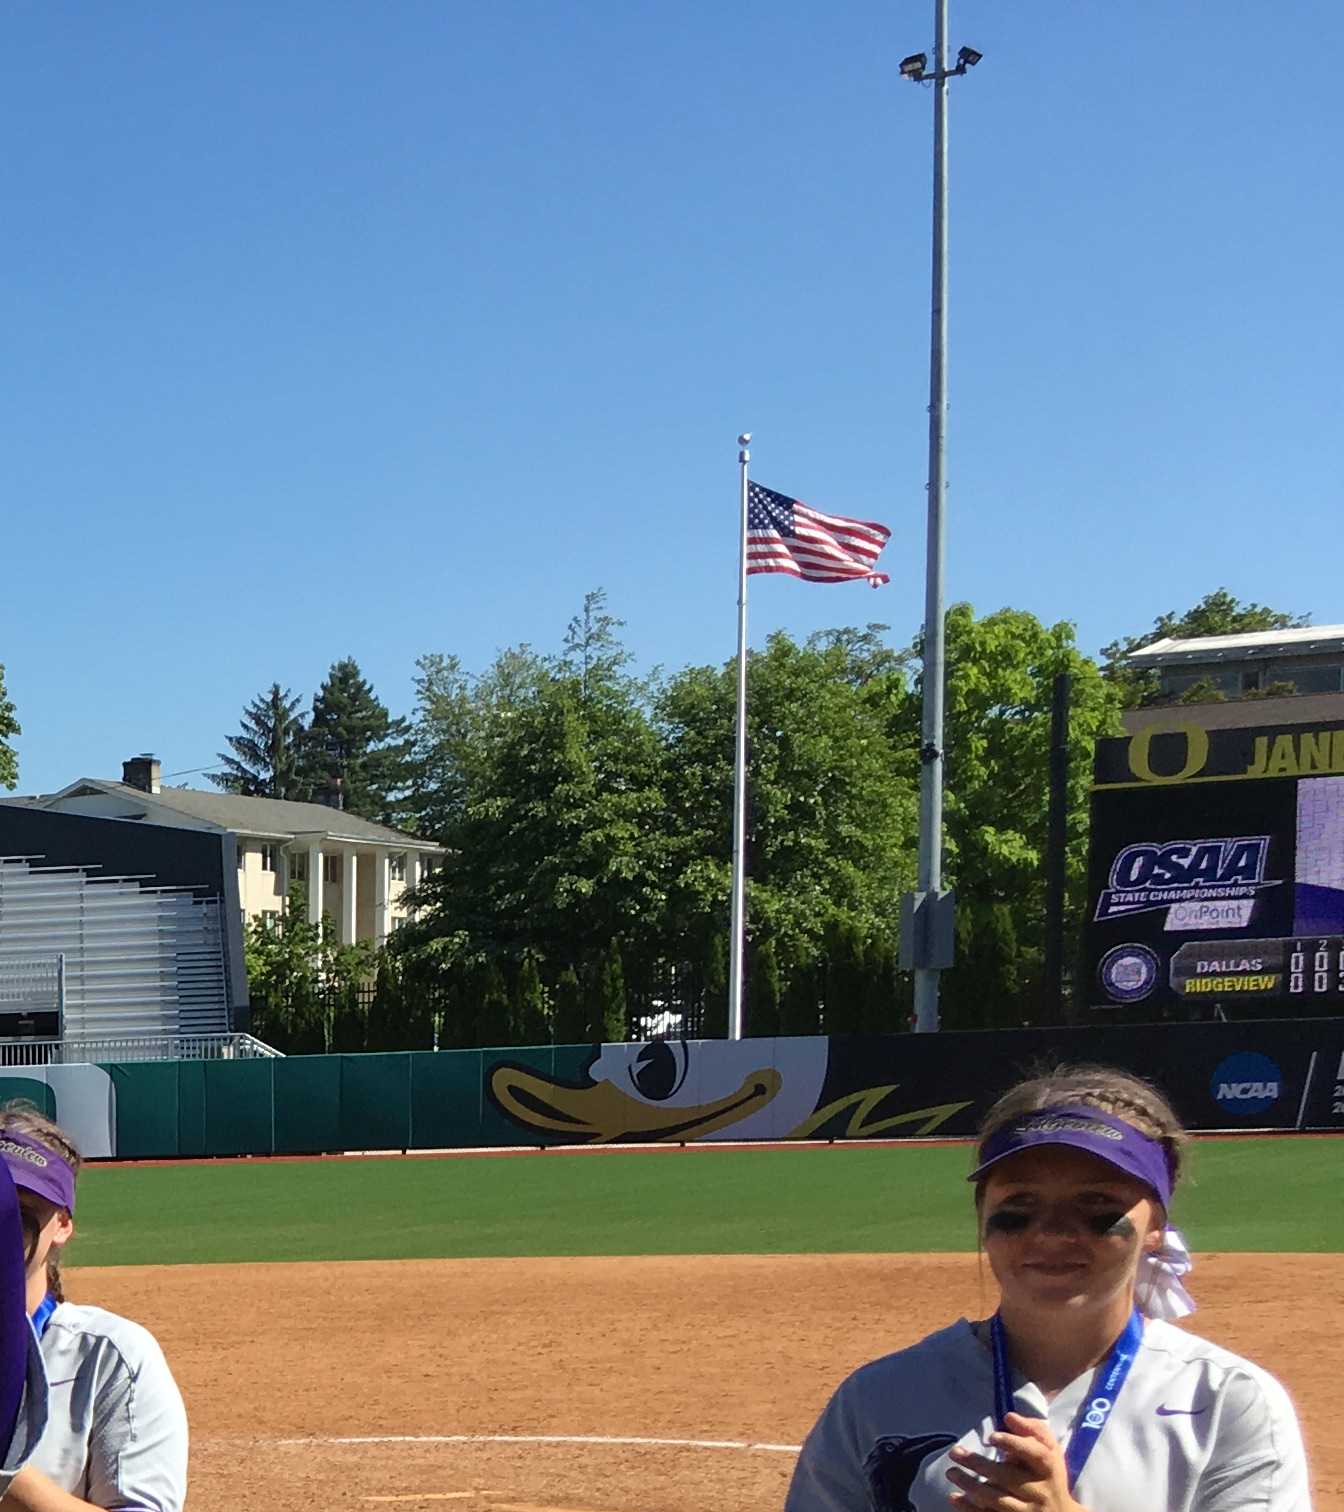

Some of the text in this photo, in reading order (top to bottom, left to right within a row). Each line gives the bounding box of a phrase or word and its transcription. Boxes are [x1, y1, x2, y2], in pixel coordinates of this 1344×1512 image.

[1246, 729, 1344, 776] JAN
[1112, 837, 1268, 890] OSAA
[1110, 885, 1257, 904] STATE CHAMPIONSHIPS
[1195, 958, 1263, 974] DALLAS
[1184, 975, 1277, 993] RIDGEVIEW
[1216, 1082, 1280, 1100] NCAA
[1081, 1397, 1111, 1429] 100
